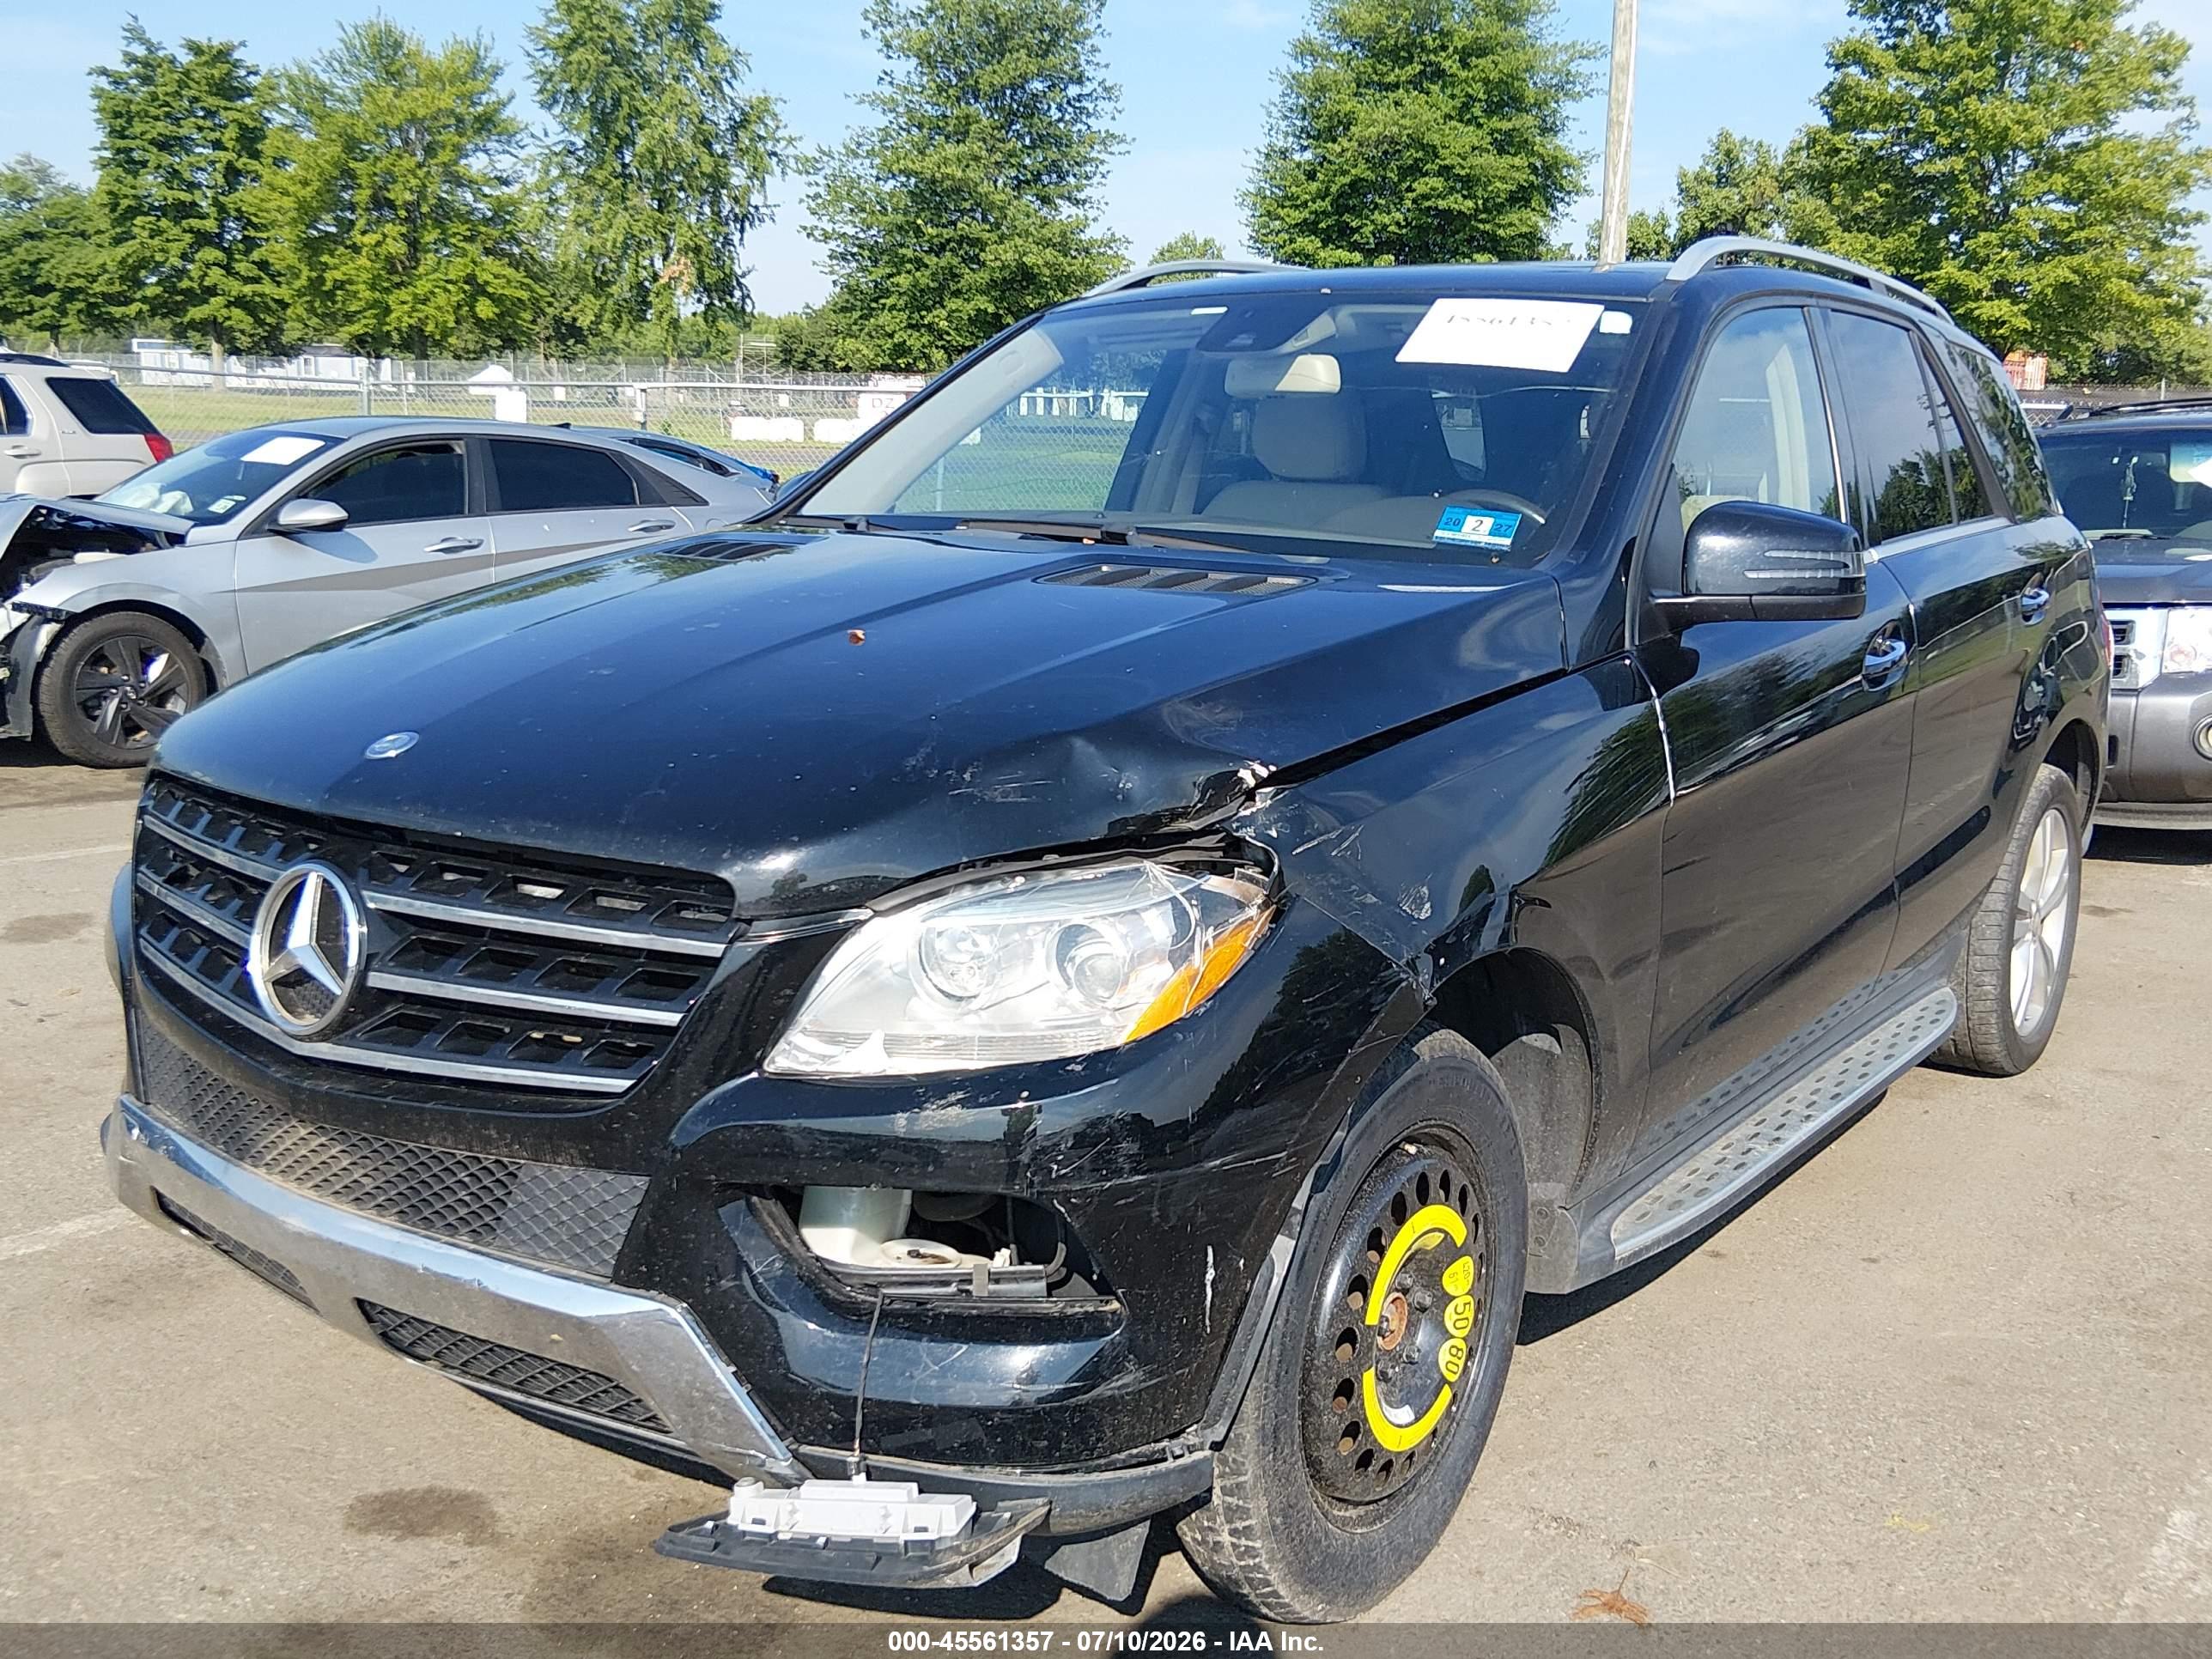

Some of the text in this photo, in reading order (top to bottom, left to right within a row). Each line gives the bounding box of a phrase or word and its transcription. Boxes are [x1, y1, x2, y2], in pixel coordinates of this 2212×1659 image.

[1444, 517, 1511, 532] 20 2 27
[1453, 1301, 1471, 1330] 50
[1445, 1345, 1464, 1375] 80
